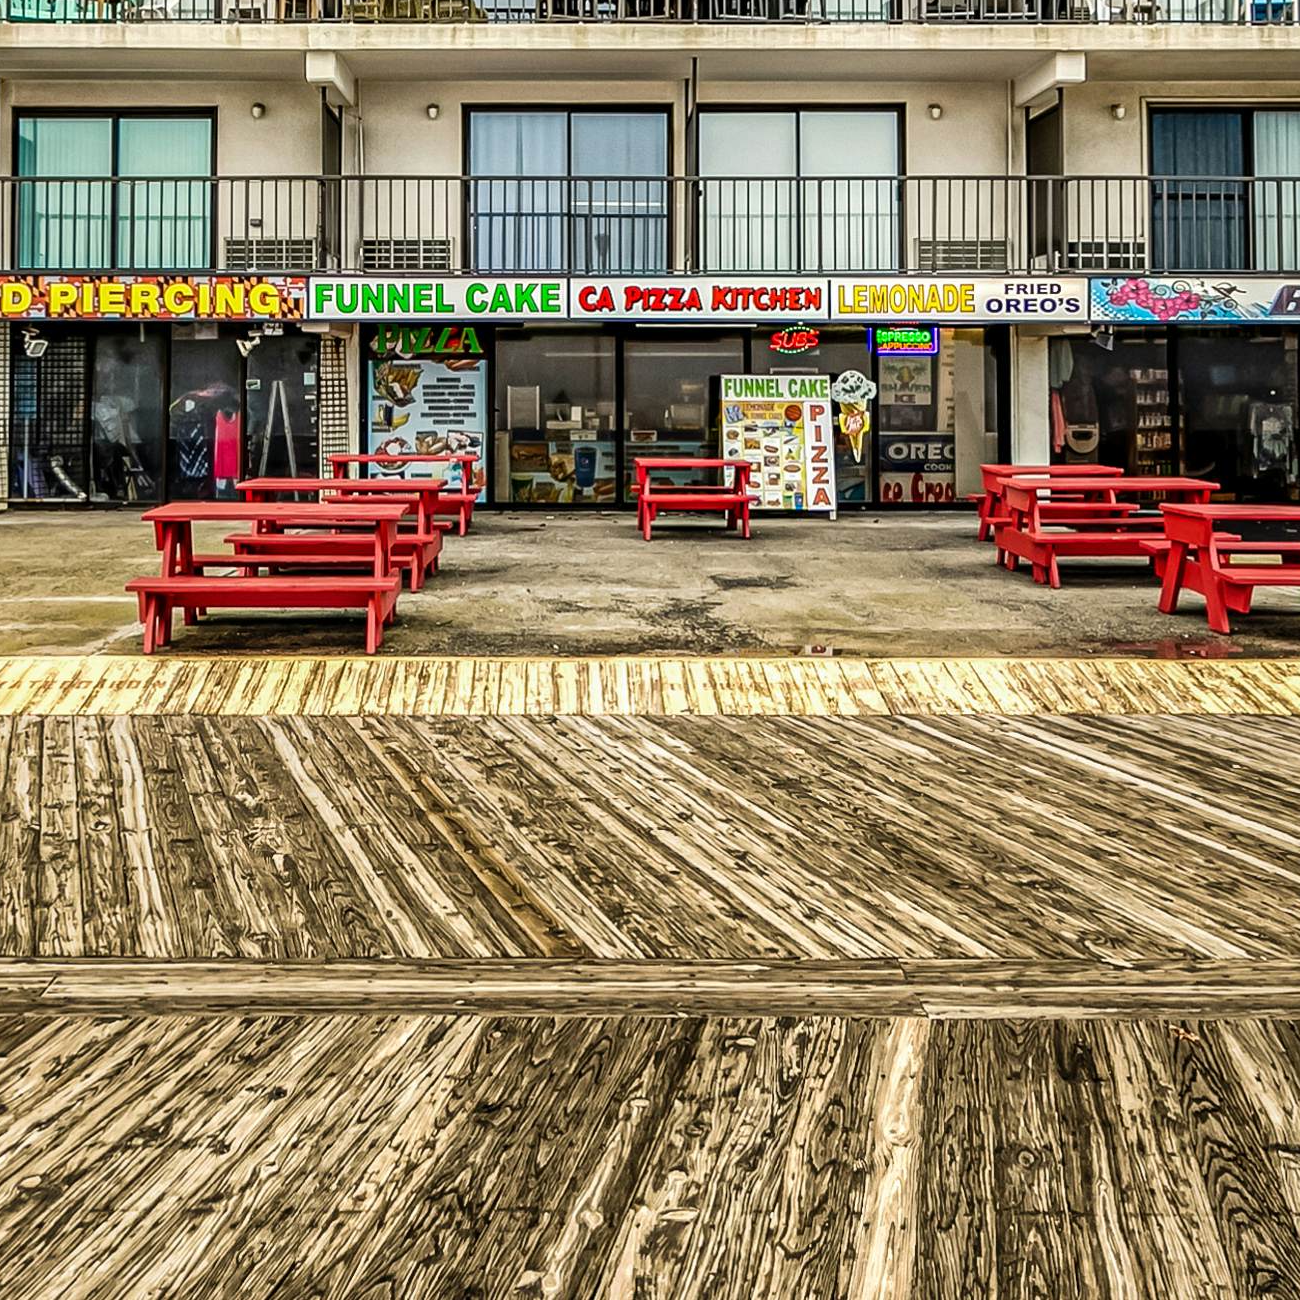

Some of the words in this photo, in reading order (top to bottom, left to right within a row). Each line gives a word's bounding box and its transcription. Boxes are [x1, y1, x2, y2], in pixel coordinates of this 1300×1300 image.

[50, 282, 280, 314] PIERCING
[315, 283, 455, 314] FUNNEL
[466, 283, 561, 314] CAKE
[578, 286, 615, 312] CA
[624, 286, 702, 312] PIZZA
[711, 285, 822, 311] KITCHEN
[838, 284, 975, 314] LEMONADE
[1004, 283, 1062, 295] FRIED
[986, 298, 1080, 313] OREO'S
[377, 324, 484, 354] PIZZA
[770, 331, 819, 348] SUBS
[876, 329, 931, 343] ESPRESSO
[724, 378, 784, 398] FUNNEL
[788, 378, 829, 398] CAKE
[809, 404, 831, 506] PIZZA
